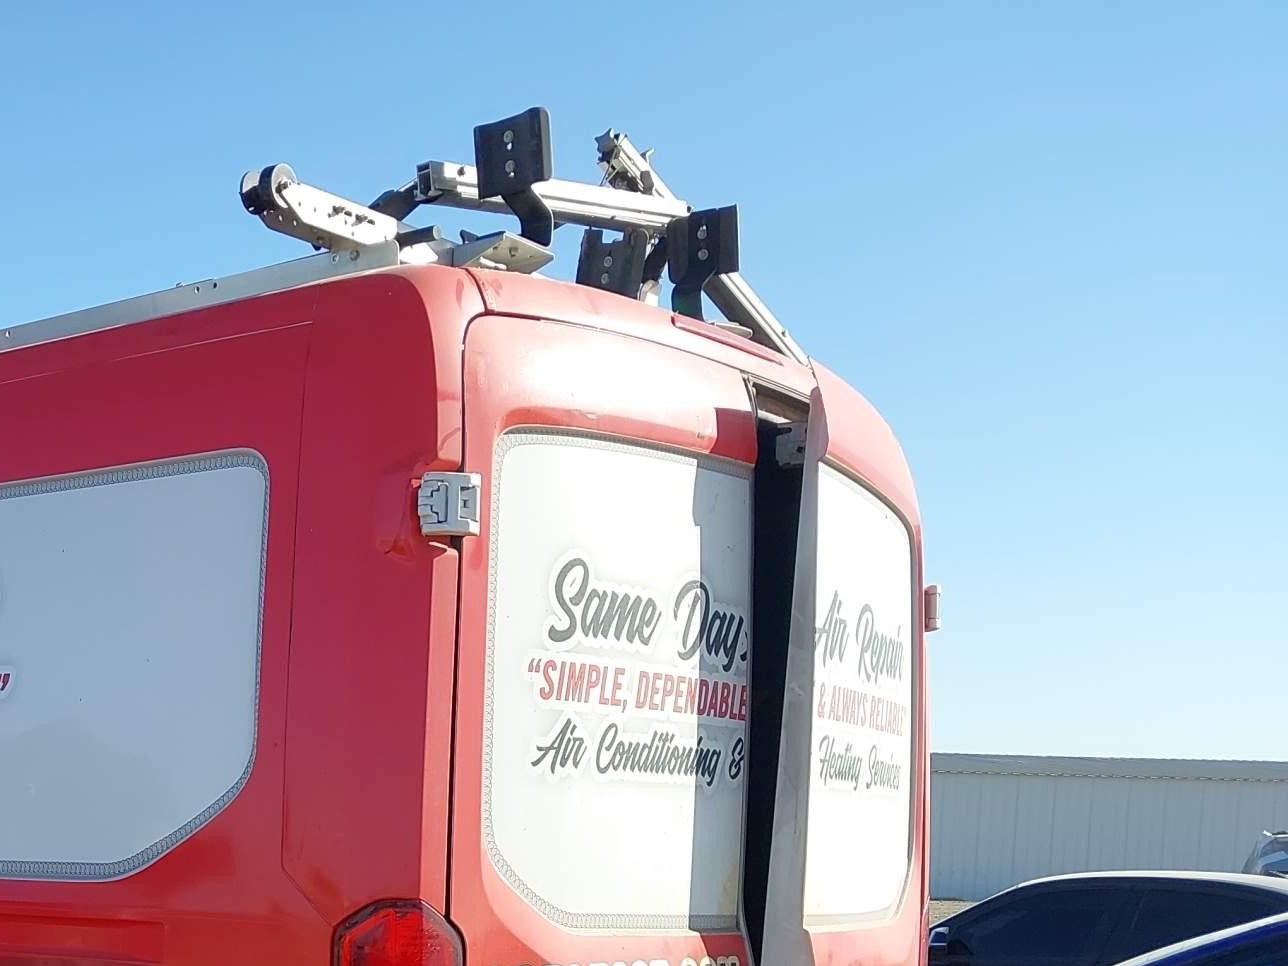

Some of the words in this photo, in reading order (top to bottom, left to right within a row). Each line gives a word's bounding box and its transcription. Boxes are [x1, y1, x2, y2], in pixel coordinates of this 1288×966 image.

[548, 557, 662, 646] Same
[673, 579, 744, 673] Day
[814, 589, 850, 669] Air
[855, 603, 905, 685] Repair
[635, 671, 747, 722] DEPENDABLE
[817, 681, 826, 719] &
[828, 685, 868, 729] ALWAYS
[531, 717, 587, 776] Air
[595, 722, 722, 787] Conditioning
[728, 736, 746, 781] &
[819, 734, 864, 792] Heating
[866, 744, 903, 791] Services
